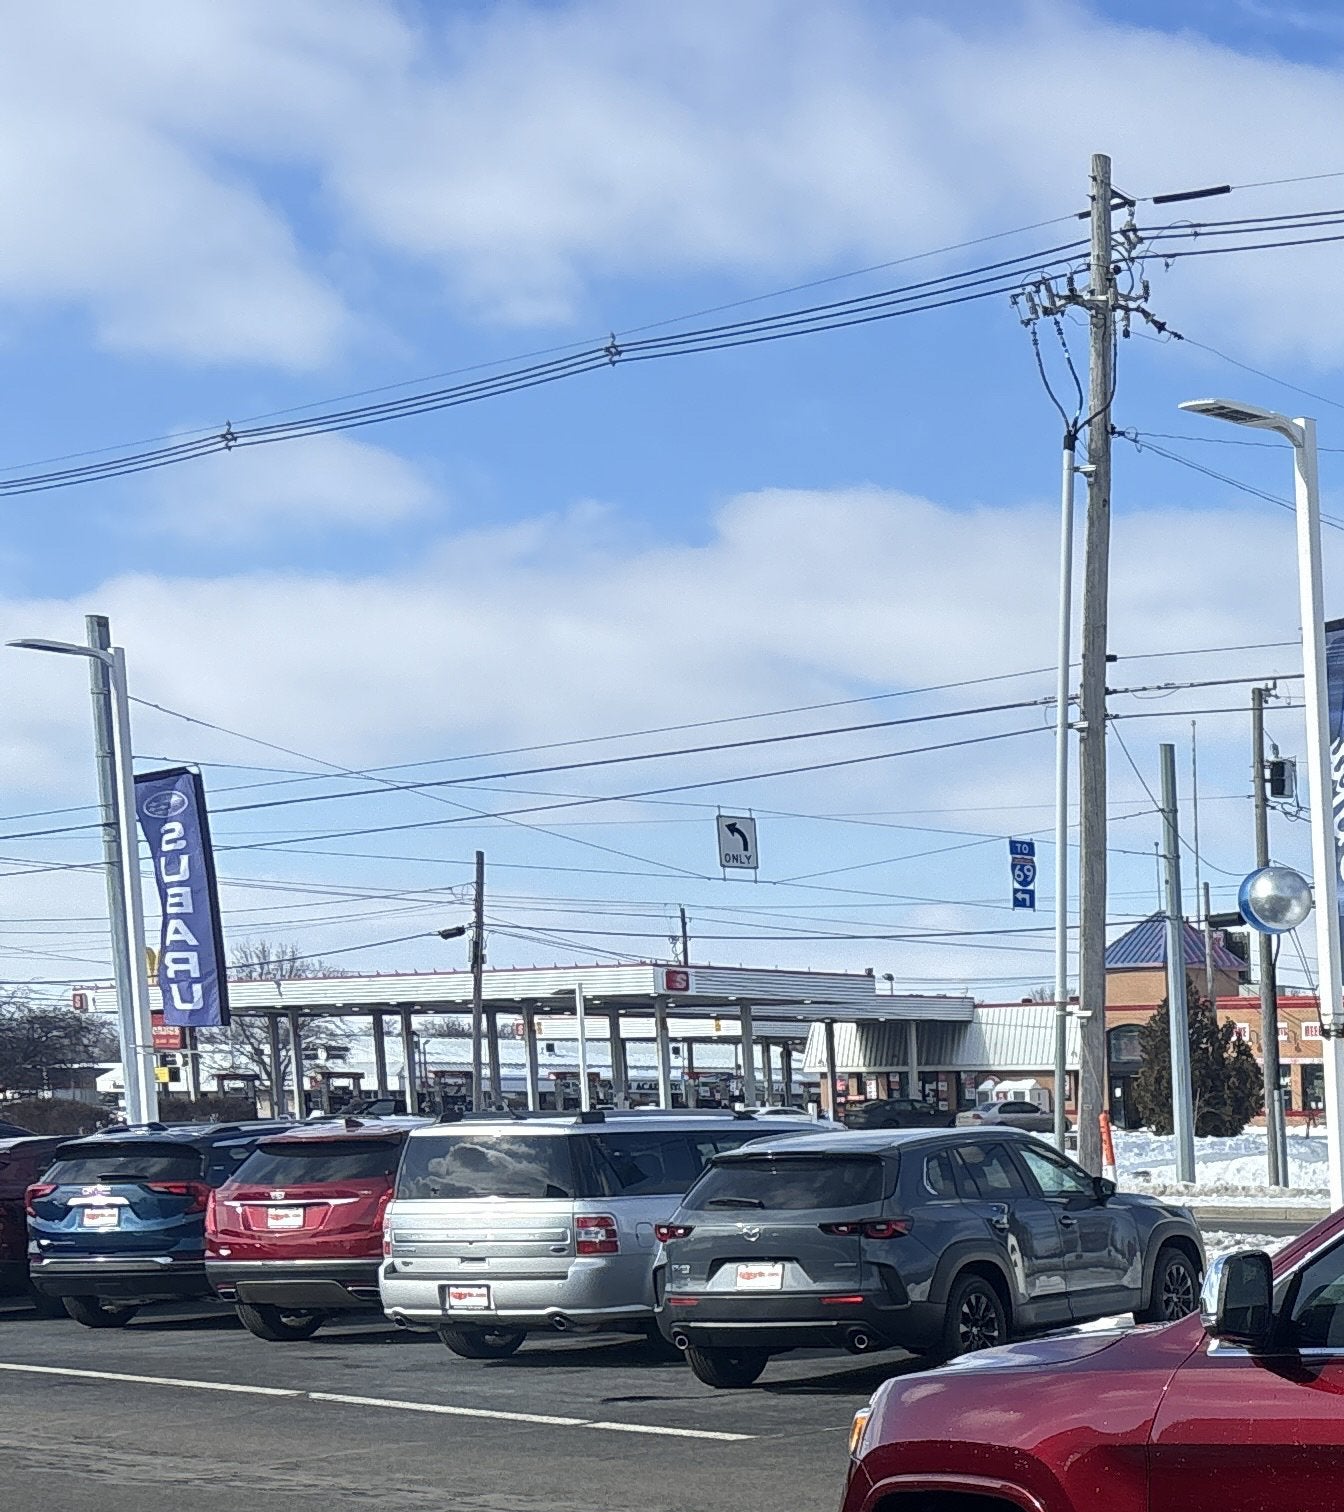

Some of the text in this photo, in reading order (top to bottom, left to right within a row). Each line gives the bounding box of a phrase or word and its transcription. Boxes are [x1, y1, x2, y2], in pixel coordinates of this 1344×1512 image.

[1015, 843, 1029, 854] TO
[724, 852, 753, 865] ONLY
[1014, 864, 1034, 882] 69
